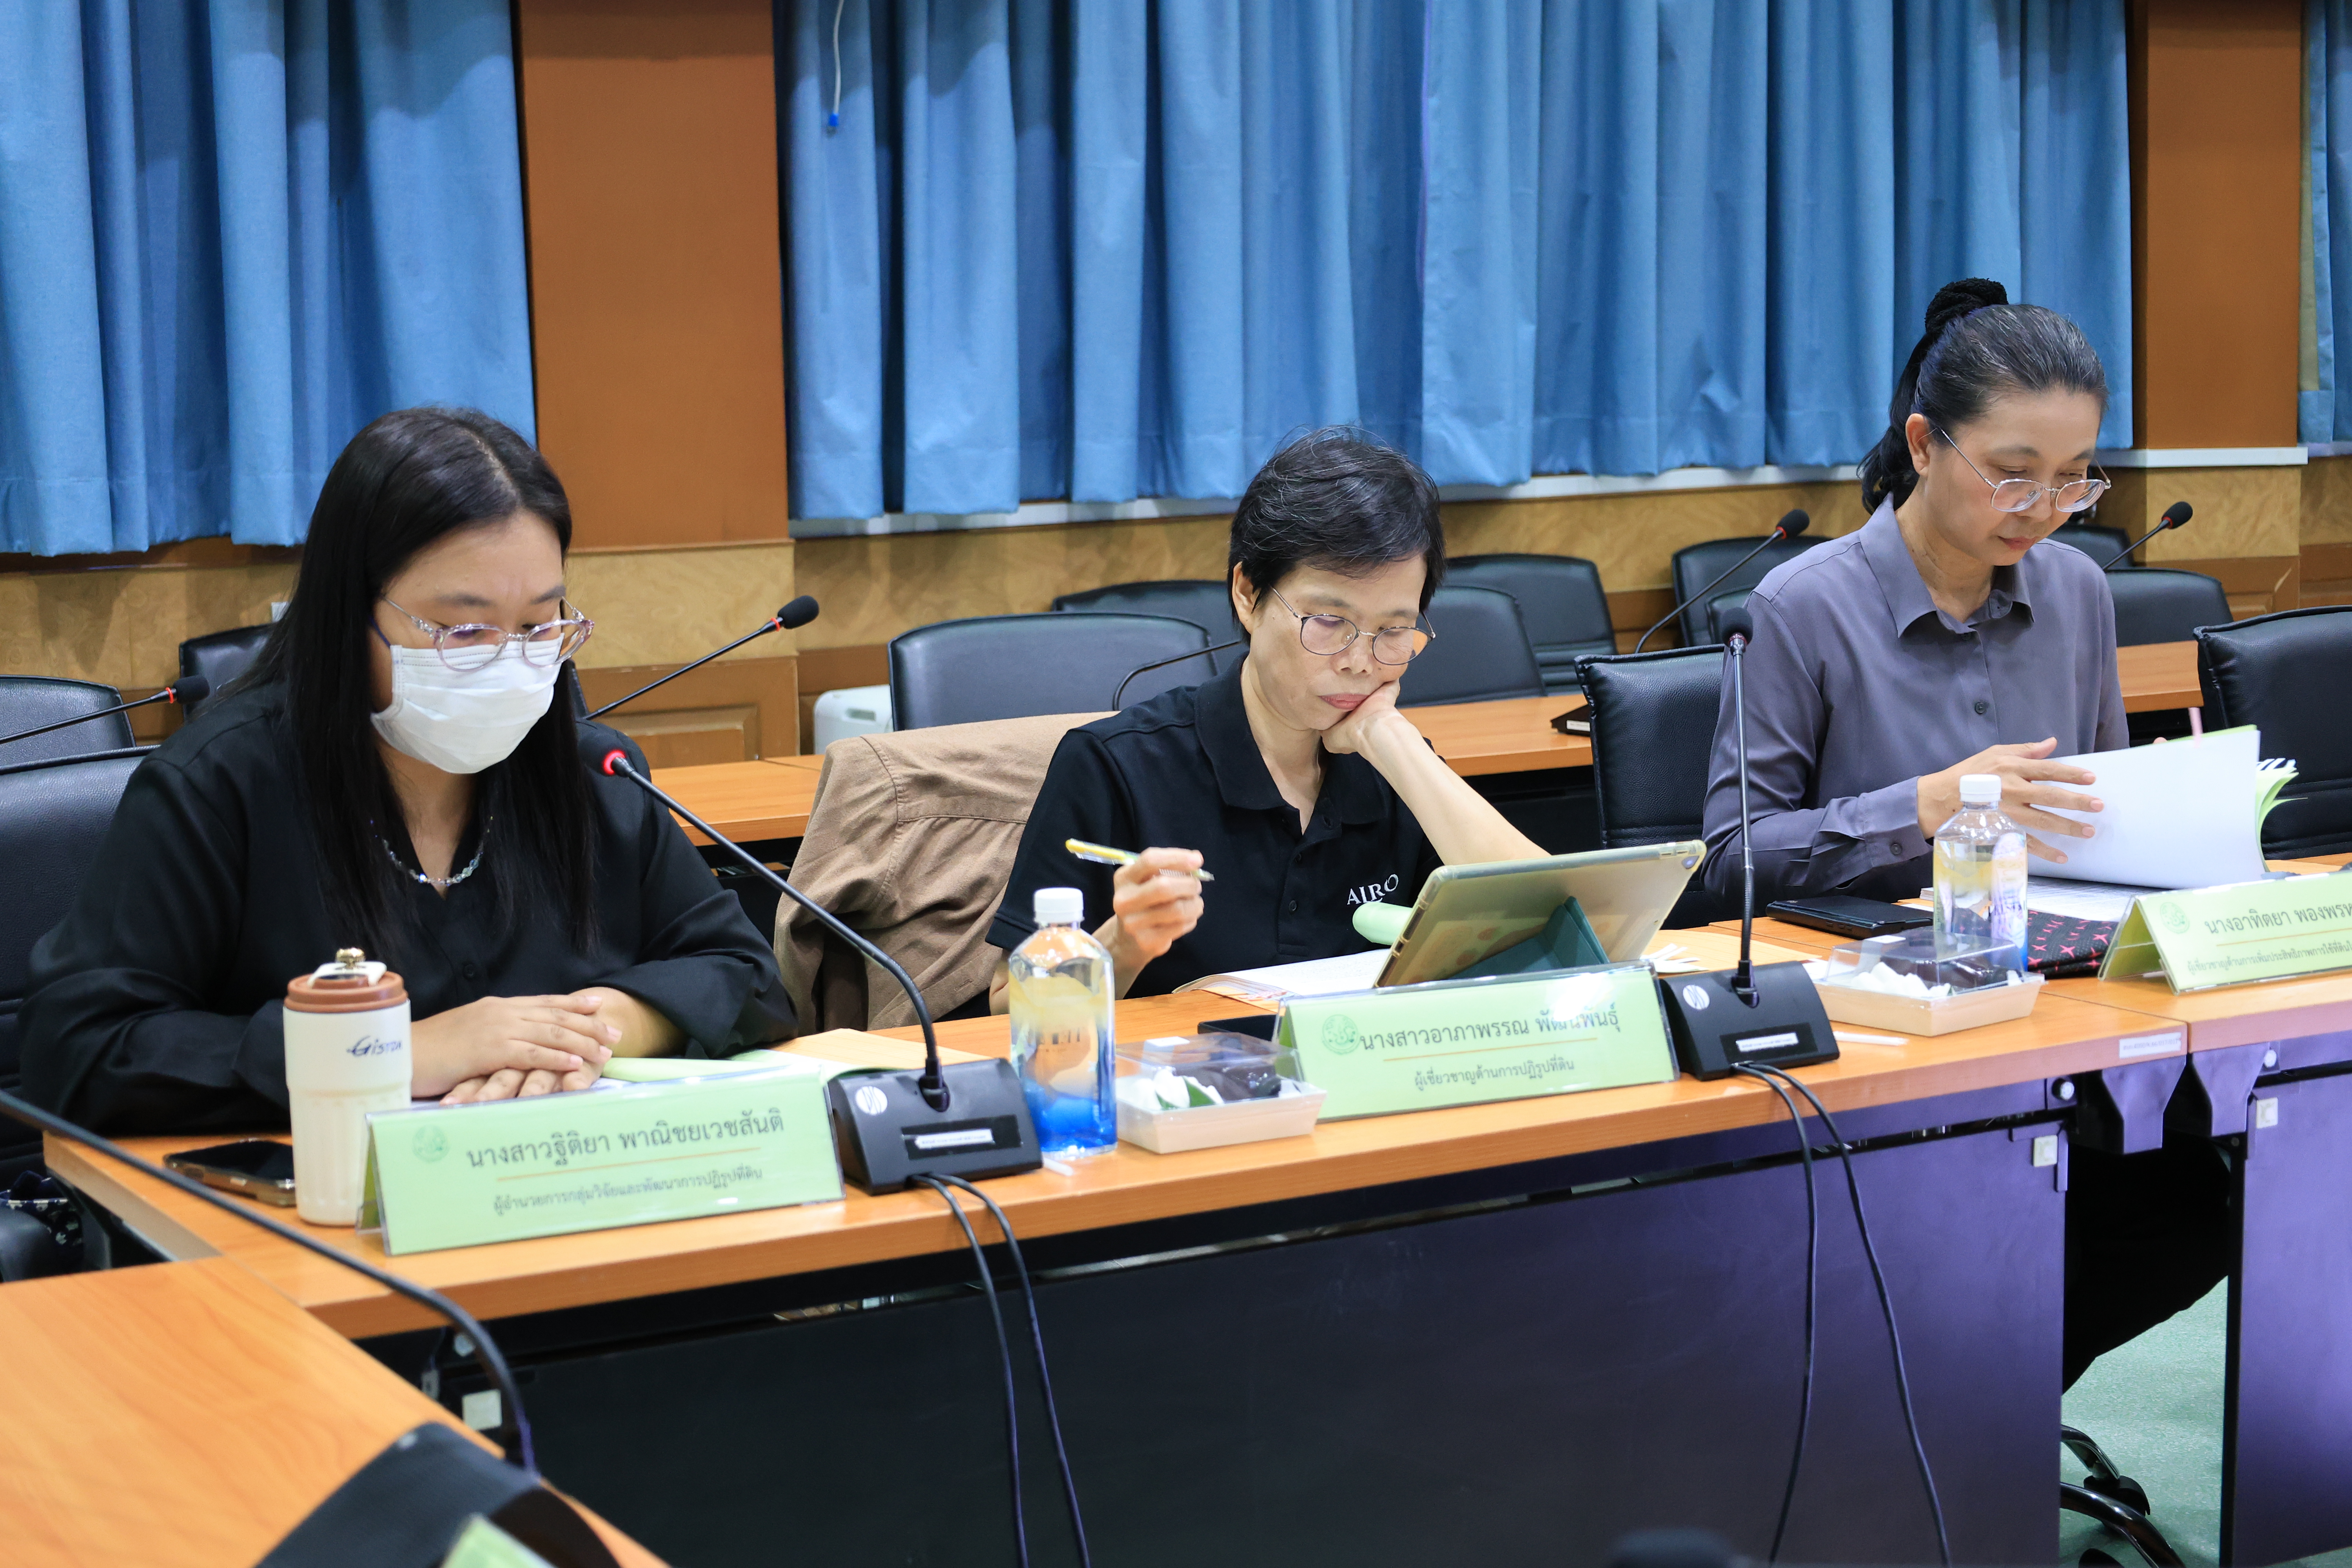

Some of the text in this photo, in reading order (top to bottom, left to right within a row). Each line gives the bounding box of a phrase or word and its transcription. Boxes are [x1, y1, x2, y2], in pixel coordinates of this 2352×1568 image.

[2204, 908, 2292, 935] นางอาทิตยา
[2187, 940, 2352, 976] ผู้เชี่ยวชาญด้านการเพิ่มประสิทธิภาพการใช้ที่ดินใ
[1359, 1018, 1530, 1050] นางสาวอาภาพรรณ
[1414, 1054, 1575, 1092] ผู้เชี่ยวชาญด้านการปฏิรูปที่ดิน
[466, 1107, 784, 1168] นางสาวฐิติยา พาณิชยเวชสันติ
